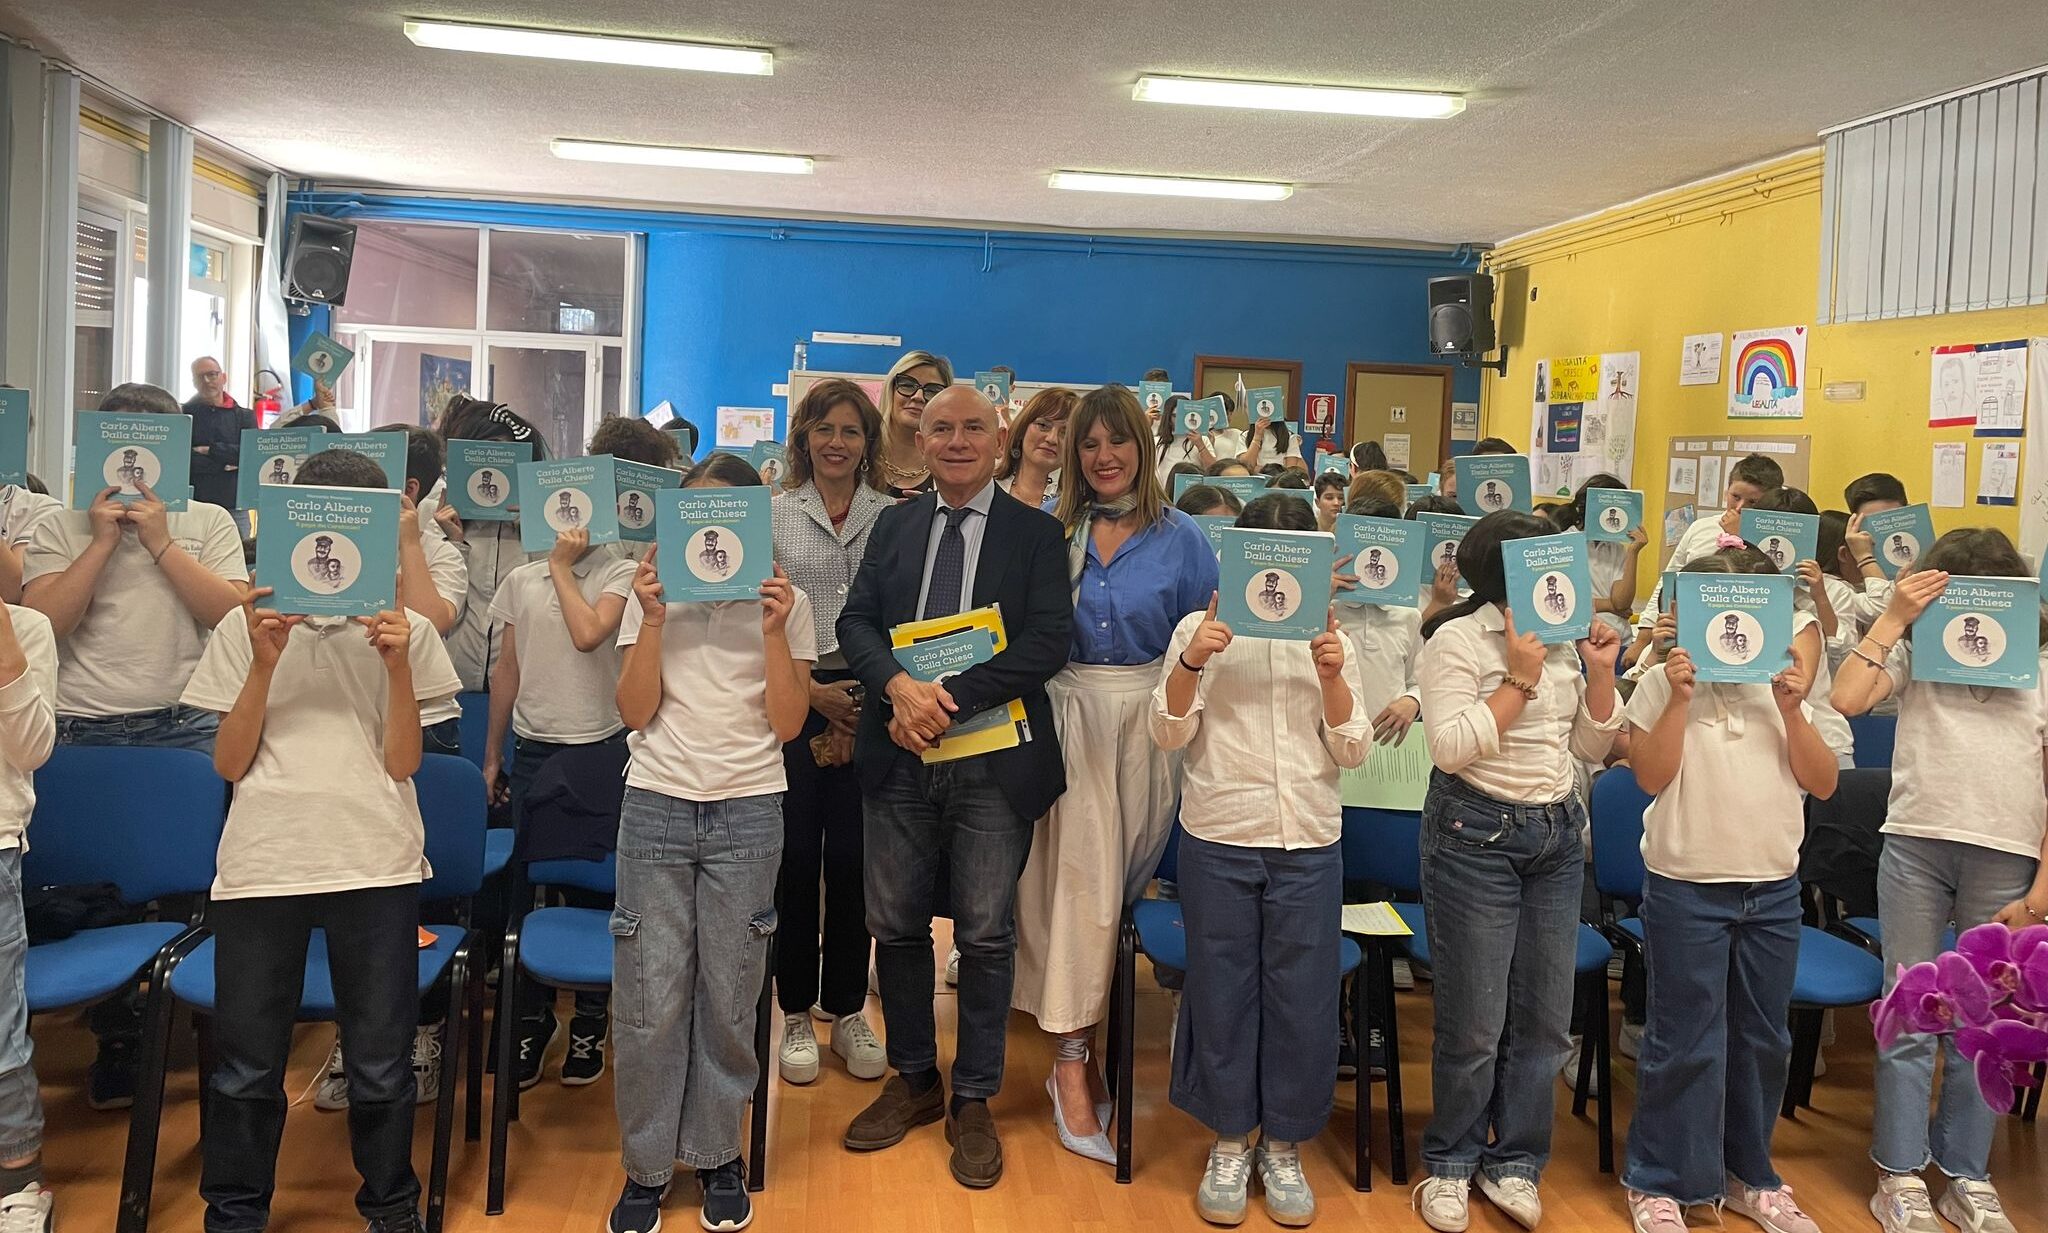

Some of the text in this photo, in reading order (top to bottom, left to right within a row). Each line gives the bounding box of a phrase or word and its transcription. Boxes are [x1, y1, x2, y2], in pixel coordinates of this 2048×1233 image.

[100, 421, 170, 433] Carlo Alberto
[101, 431, 167, 441] Dalla Chiesa
[256, 435, 308, 444] Carlo Alberto
[258, 443, 279, 451] Dalla
[328, 441, 388, 450] Carlo Alberto
[463, 448, 516, 457] Carlo Alberto
[465, 455, 514, 464] Dalla Chiesa
[536, 465, 595, 478] Carlo Alberto
[615, 467, 665, 483] Carlo Alberto
[538, 473, 594, 485] Dalla Chiesa
[616, 475, 662, 489] Dalla Chiesa
[286, 499, 372, 513] Carlo Alberto
[678, 499, 748, 509] Carlo Alberto
[288, 511, 369, 524] Dalla Chiesa
[680, 510, 747, 519] Dalla Chiesa
[1871, 513, 1916, 527] Carlo Alberto
[1431, 521, 1451, 529] Carlo
[1755, 517, 1804, 528] Carlo Alberto
[1755, 523, 1801, 533] Dalla Chiesa
[1873, 518, 1917, 532] Dalla Chiesa
[1353, 523, 1407, 536] Carlo Alberto
[1354, 531, 1405, 543] Dalla Chiesa
[1243, 541, 1312, 555] Carlo Alberto
[1523, 545, 1574, 558] Carlo Alberto
[1244, 551, 1309, 564] Dalla Chiesa
[1525, 555, 1574, 567] Dalla Chiesa
[1699, 584, 1770, 595] Carlo Alberto
[1970, 588, 2015, 598] Alberto
[1701, 594, 1769, 604] Dalla Chiesa
[1939, 595, 2012, 608] Dalla Chiesa
[912, 642, 973, 663] Carlo Alberto
[916, 652, 974, 672] Dalla Chiesa
